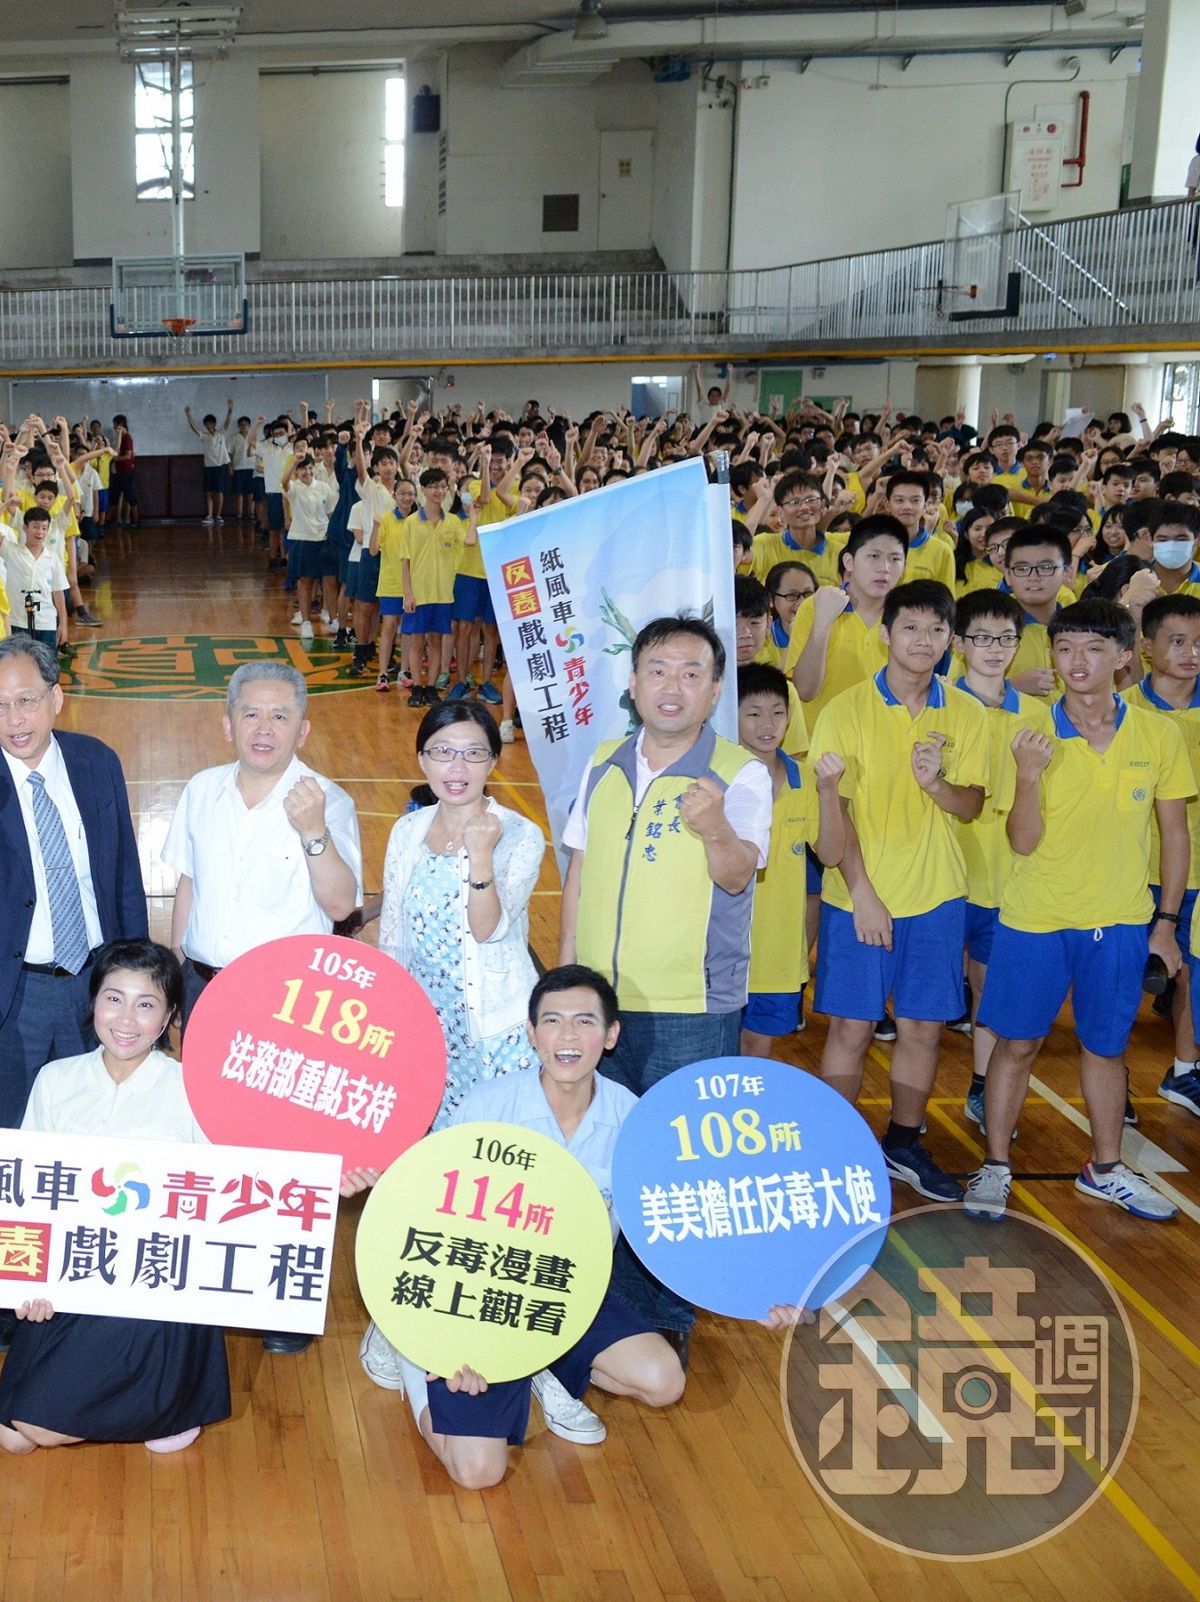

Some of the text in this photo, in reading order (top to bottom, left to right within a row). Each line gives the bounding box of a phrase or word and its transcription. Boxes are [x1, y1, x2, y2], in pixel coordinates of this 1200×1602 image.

[540, 547, 594, 726] 紙風車 青少年
[308, 947, 376, 989] 105年
[272, 978, 395, 1059] 118所
[221, 1030, 397, 1134] 法務部重點支持
[694, 1074, 765, 1100] 107年
[472, 1137, 537, 1171] 106年
[670, 1108, 802, 1161] 108所
[159, 1171, 332, 1232] 青少年
[436, 1169, 554, 1235] 114所
[640, 1165, 881, 1244] 美美擔任反毒大使
[399, 1226, 576, 1293] 反毒漫畫
[391, 1271, 566, 1336] 線上觀看
